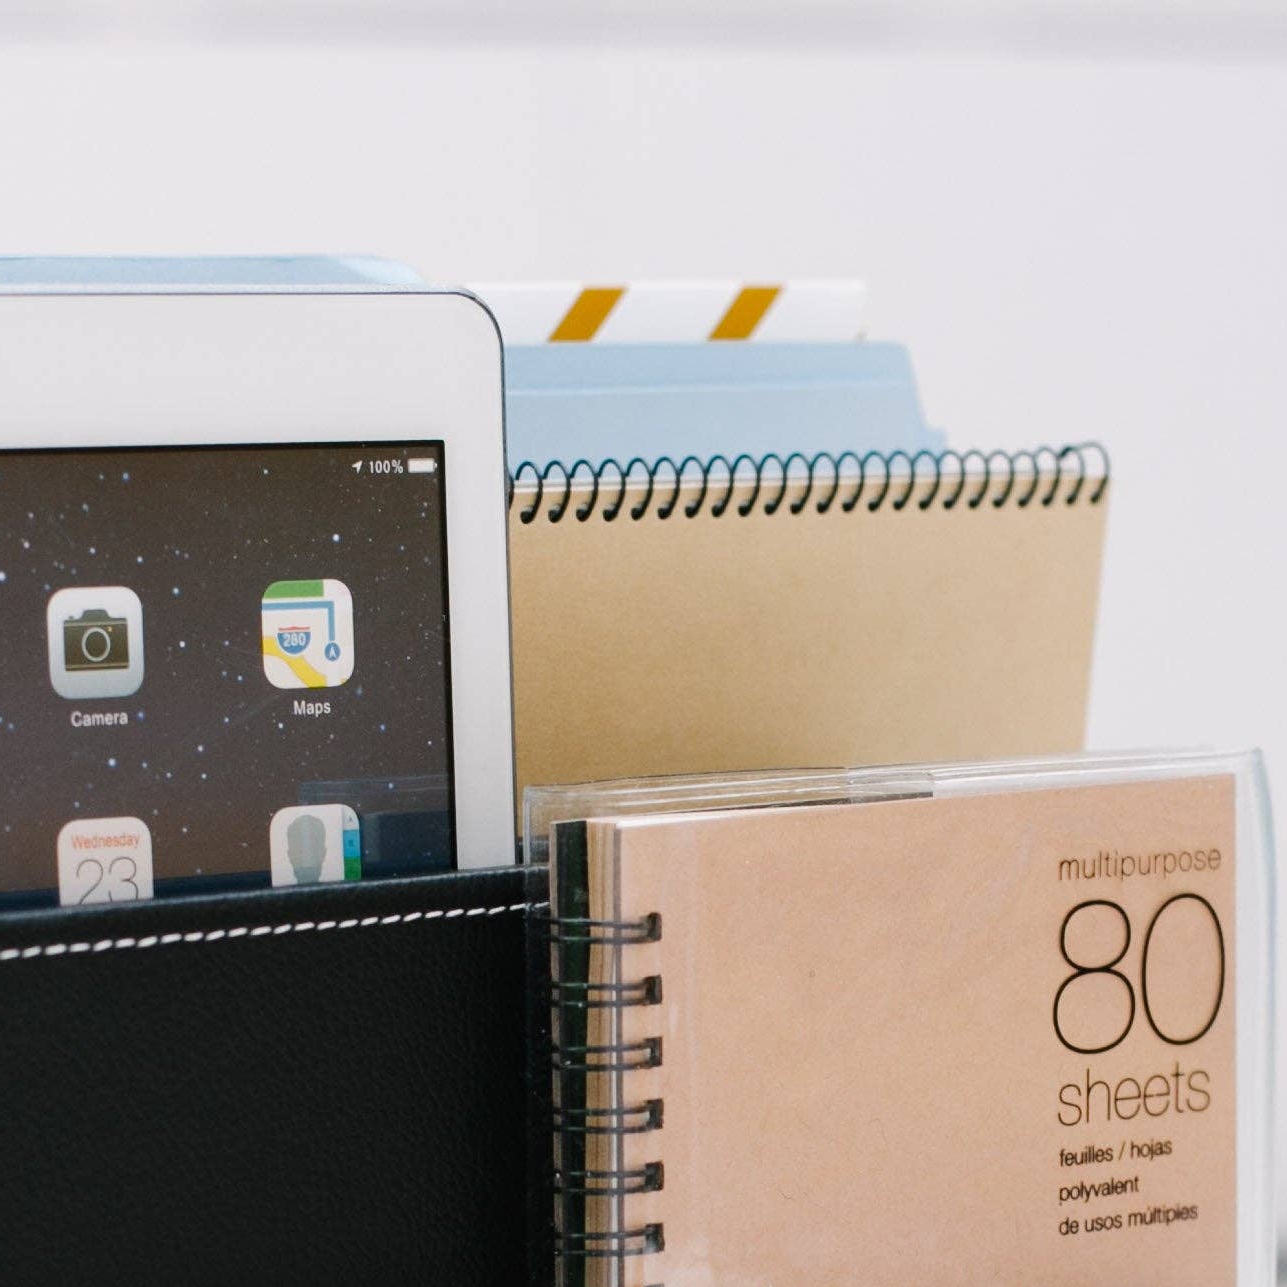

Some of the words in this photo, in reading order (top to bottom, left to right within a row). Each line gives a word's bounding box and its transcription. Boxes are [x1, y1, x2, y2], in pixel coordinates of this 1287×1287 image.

[368, 459, 404, 475] 100%
[283, 631, 307, 648] 280
[71, 711, 129, 728] Camera
[293, 700, 331, 718] Maps
[72, 834, 139, 849] Wednesday
[1058, 847, 1222, 882] multipurpose
[76, 856, 139, 904] 23
[1053, 893, 1225, 1054] 80
[1058, 1062, 1211, 1126] sheets
[1060, 1144, 1114, 1166] feuilles
[1130, 1137, 1173, 1162] hojas
[1059, 1176, 1140, 1204] polyvalent
[1059, 1217, 1080, 1236] de
[1084, 1214, 1123, 1233] usos
